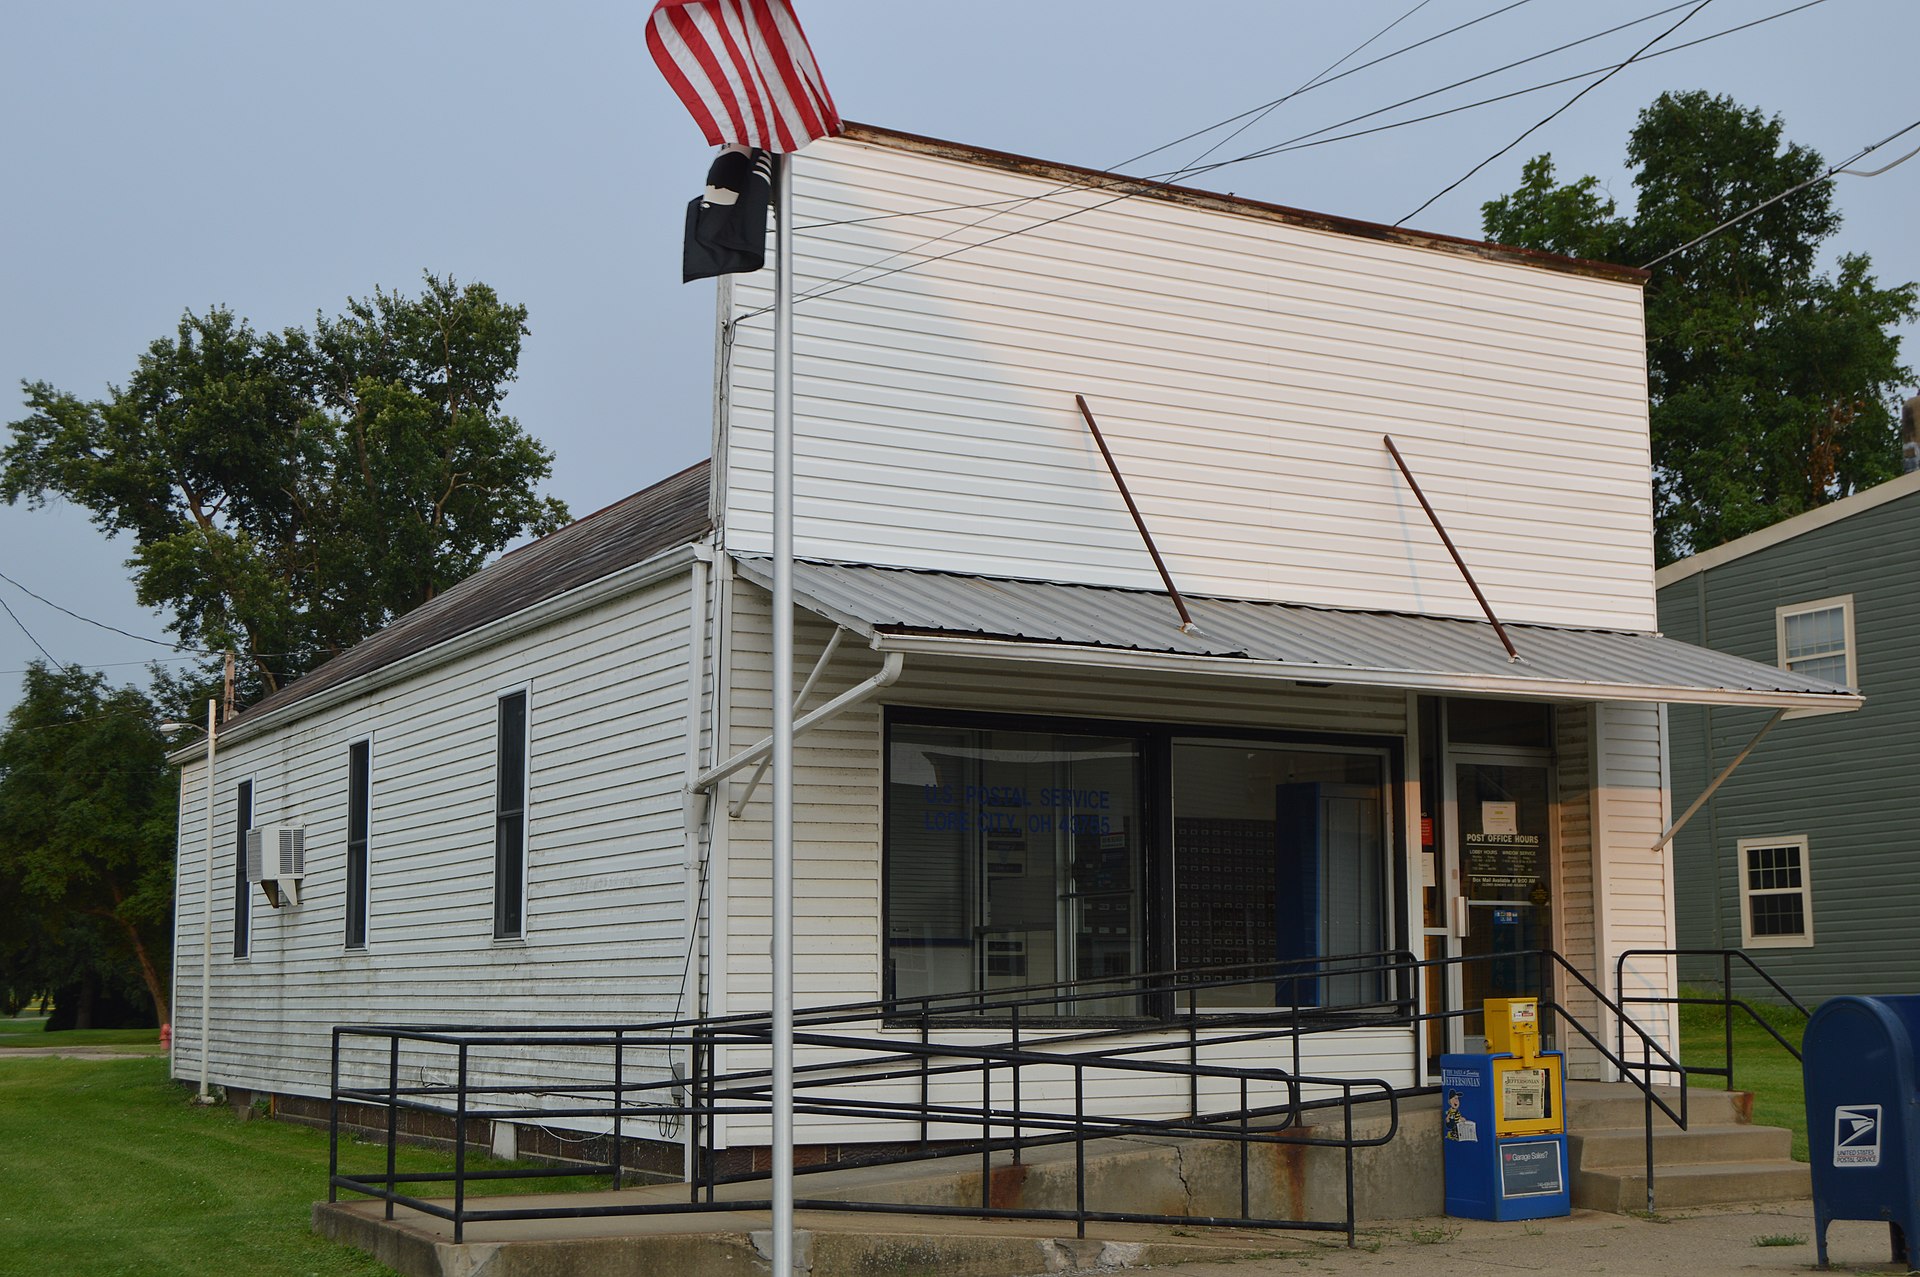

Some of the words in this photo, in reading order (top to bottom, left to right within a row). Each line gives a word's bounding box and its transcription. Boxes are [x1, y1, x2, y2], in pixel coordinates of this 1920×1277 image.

[966, 785, 1031, 807] POSTAL
[1040, 788, 1110, 809] SERVICE
[924, 811, 969, 832] LORE
[1028, 815, 1051, 833] OH
[1466, 834, 1485, 842] POST
[1488, 834, 1513, 843] OFFICE
[1514, 835, 1539, 844] HOURS
[1512, 1153, 1531, 1162] Garage
[1531, 1151, 1548, 1160] Sales?
